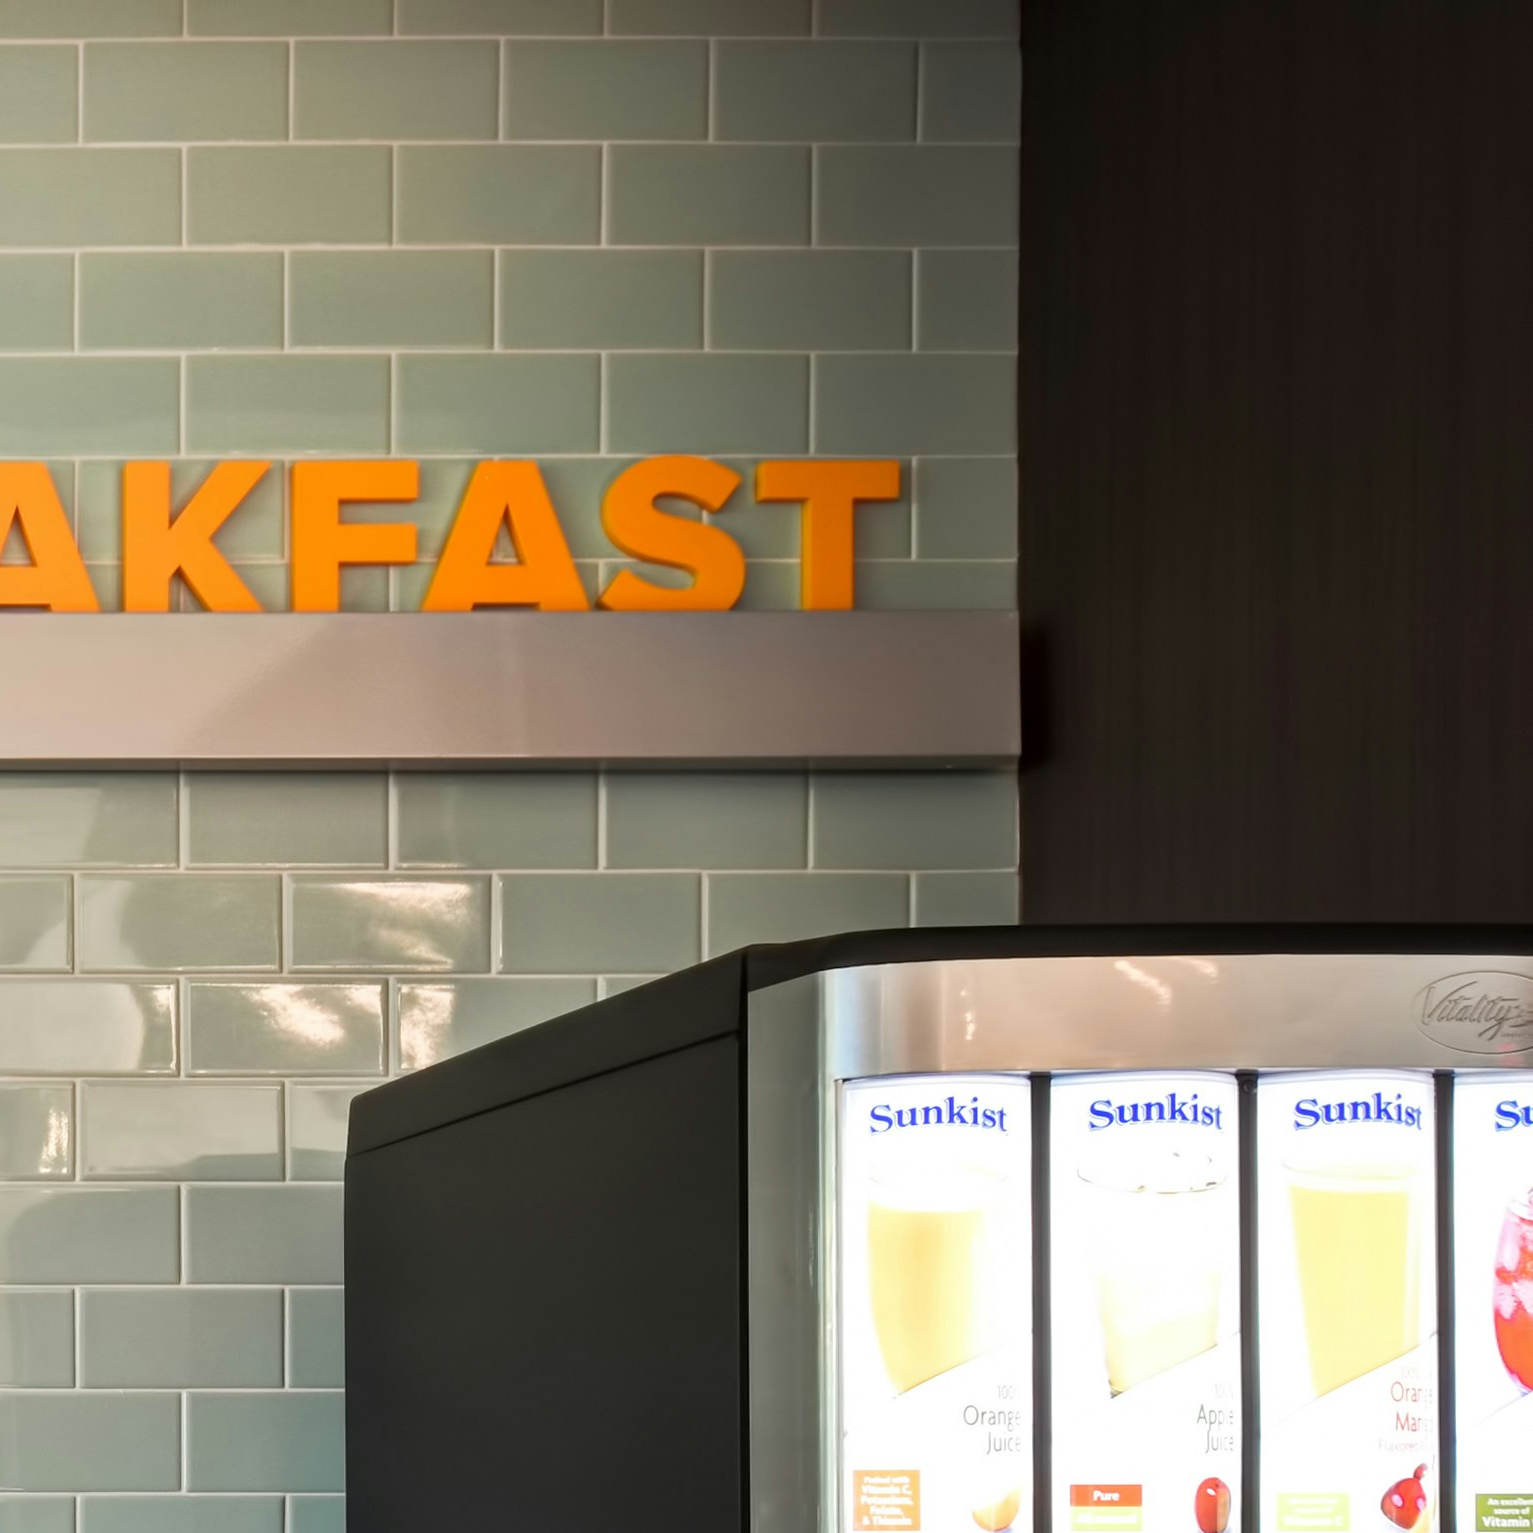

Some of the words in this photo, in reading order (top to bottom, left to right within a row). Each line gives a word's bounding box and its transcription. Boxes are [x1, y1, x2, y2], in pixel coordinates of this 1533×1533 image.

[1421, 980, 1521, 1040] Vitality
[869, 1096, 1008, 1134] Sunkist
[1088, 1093, 1223, 1131] Sunkist
[1294, 1092, 1422, 1131] Sunkist
[963, 1405, 1021, 1432] Orange
[1197, 1404, 1234, 1432] Apple
[986, 1431, 1021, 1455] Juice
[1093, 1490, 1120, 1501] Pure
[1482, 1516, 1531, 1527] Vitamin
